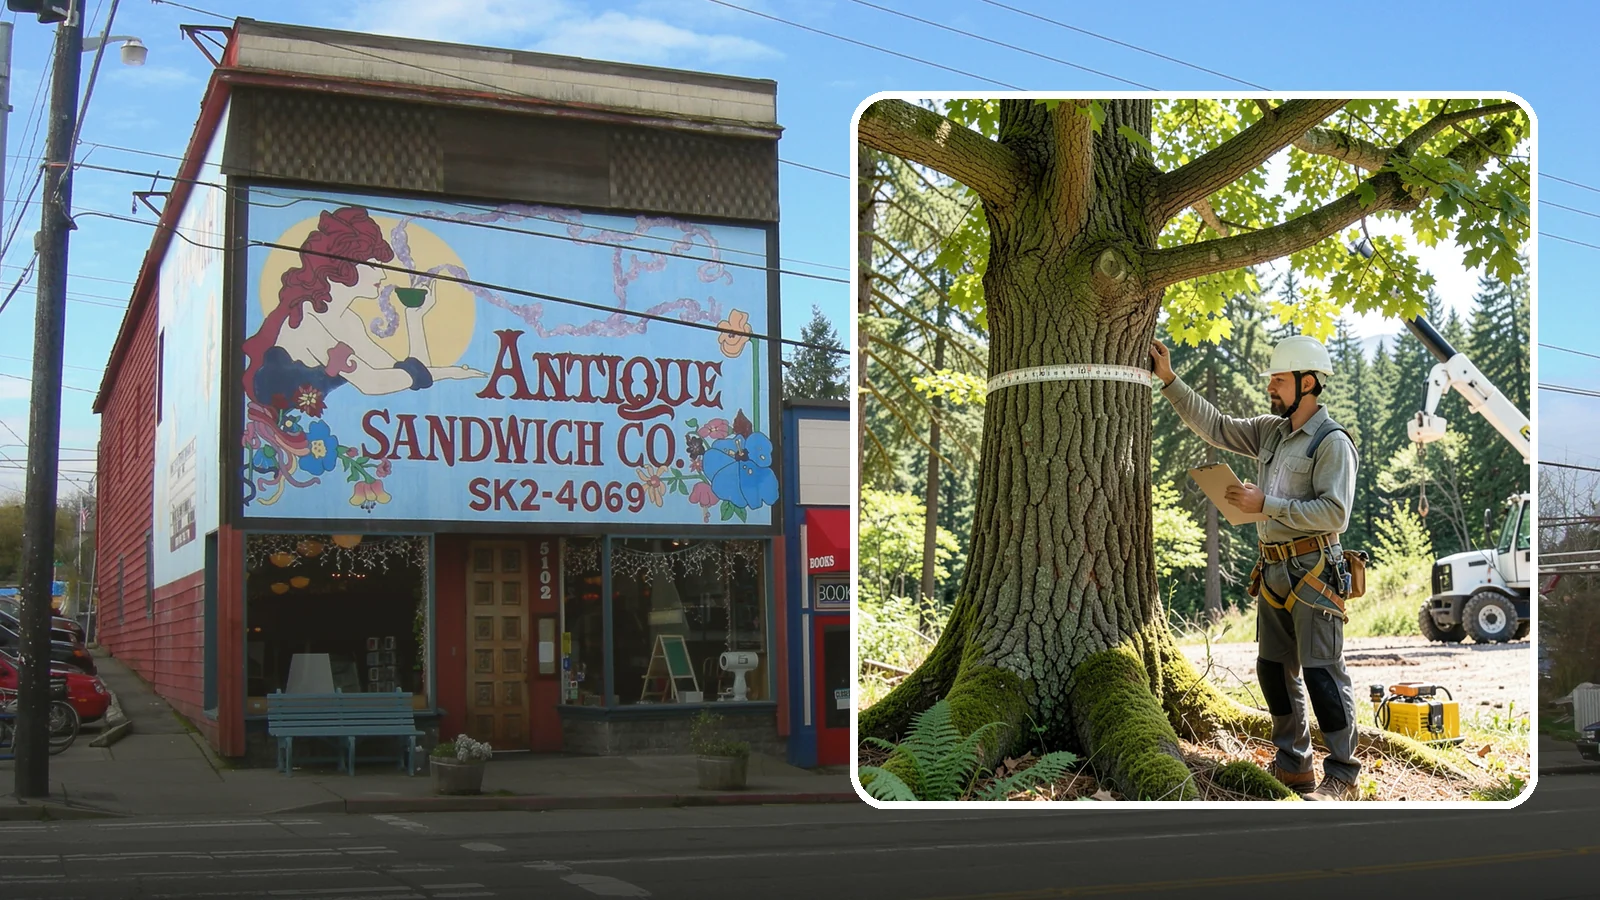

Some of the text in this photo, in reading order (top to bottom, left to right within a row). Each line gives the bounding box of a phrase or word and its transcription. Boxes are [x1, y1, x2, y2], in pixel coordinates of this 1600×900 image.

[476, 329, 723, 420] ANTIQUE
[361, 408, 685, 468] SANDWICH CO.
[468, 477, 646, 512] SK2-4069
[540, 542, 551, 599] 5102
[809, 555, 835, 569] BOOKS
